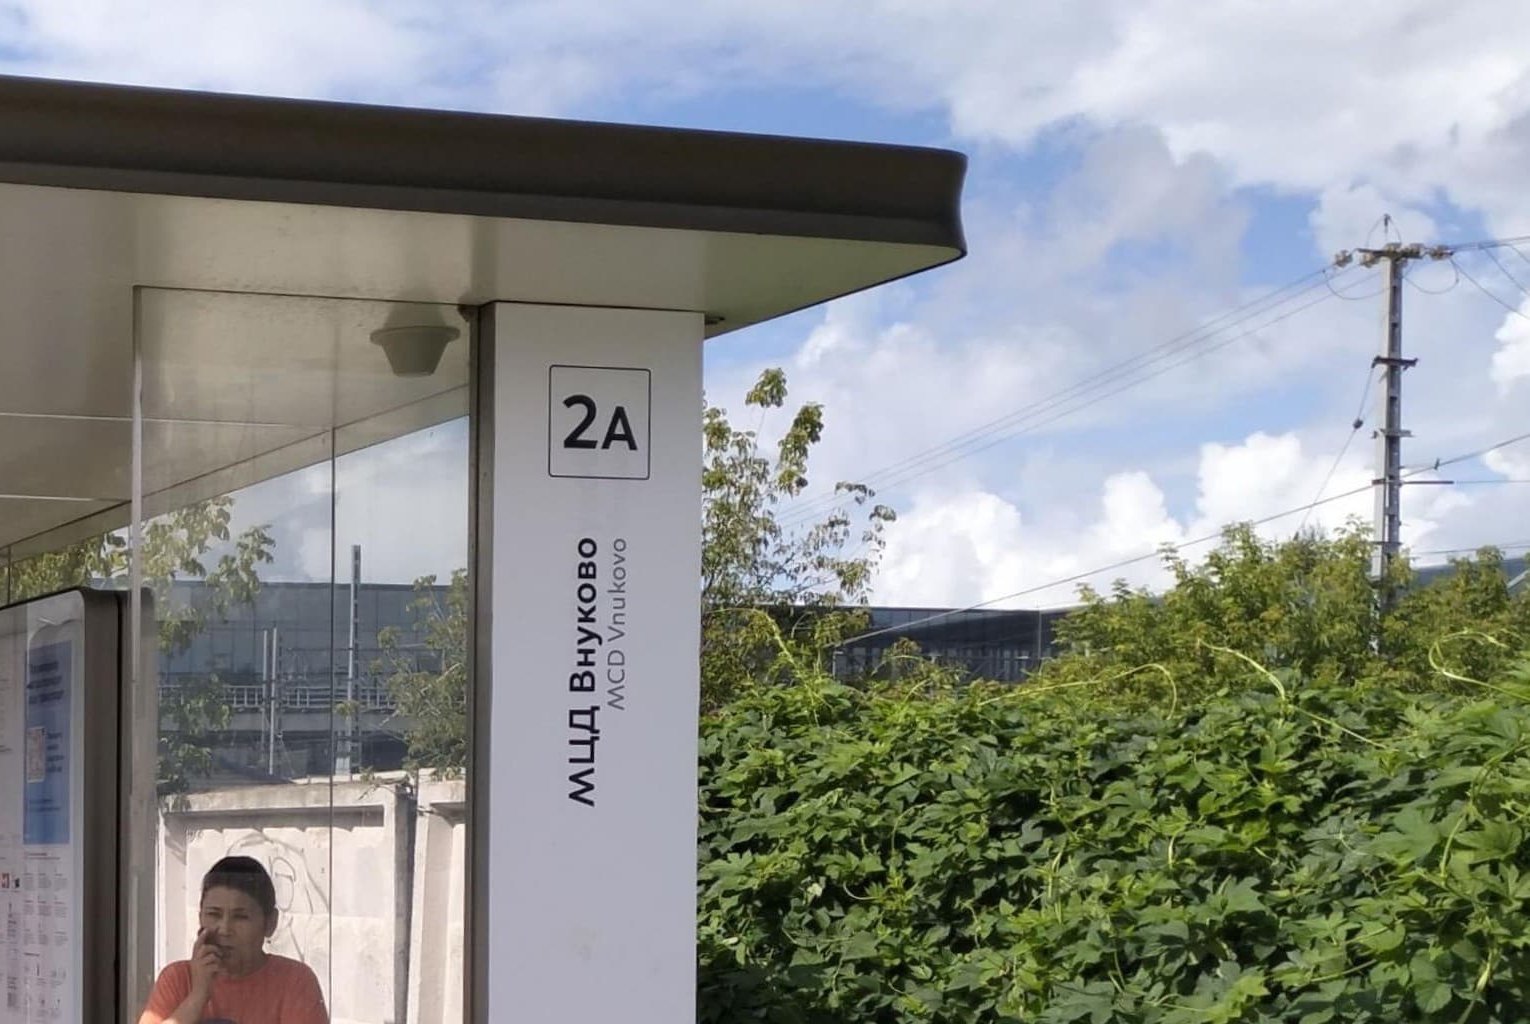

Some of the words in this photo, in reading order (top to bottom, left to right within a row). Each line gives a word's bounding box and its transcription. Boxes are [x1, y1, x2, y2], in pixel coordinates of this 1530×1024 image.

[568, 537, 603, 692] Внуково
[606, 538, 627, 642] Vnukovo
[606, 649, 625, 711] MCD
[568, 705, 601, 808] МЦД
